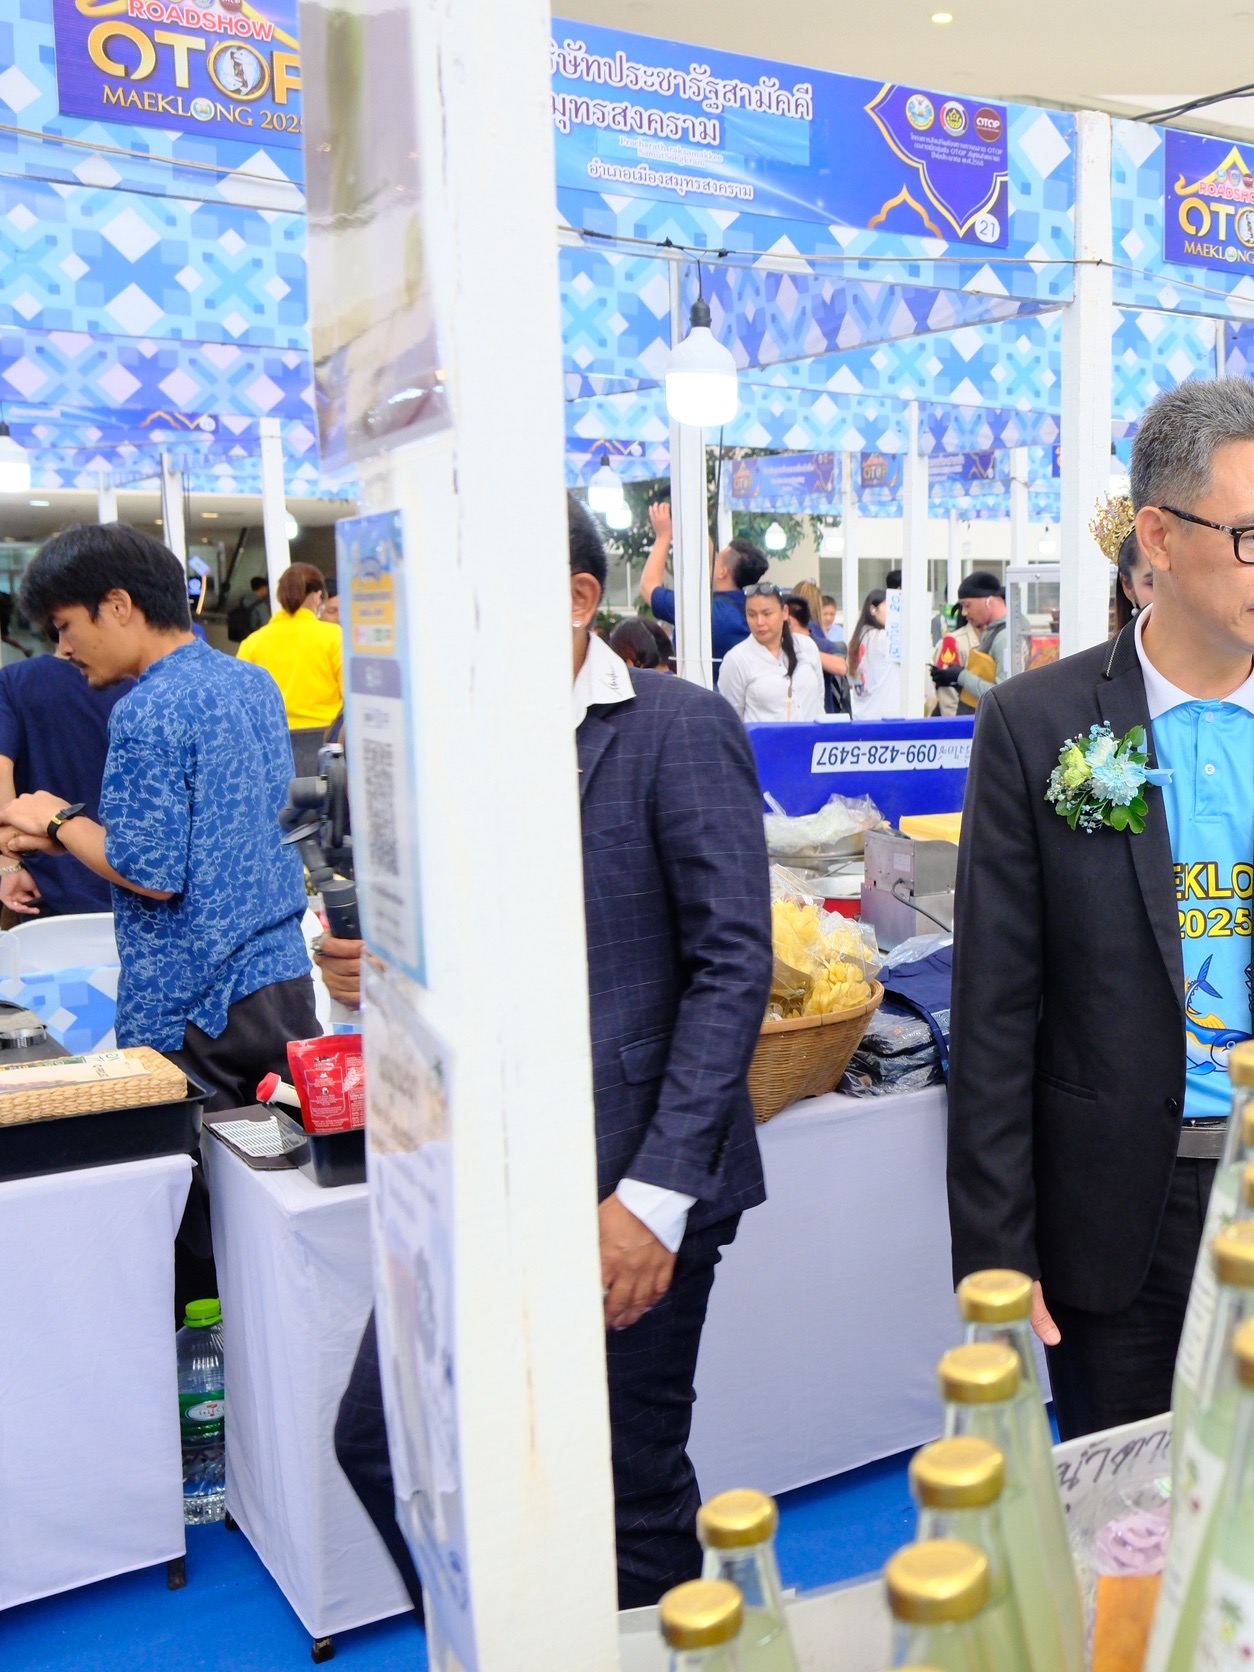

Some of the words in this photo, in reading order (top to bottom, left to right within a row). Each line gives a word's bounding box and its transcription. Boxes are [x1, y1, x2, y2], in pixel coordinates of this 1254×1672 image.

[128, 0, 274, 41] ROADSHOW
[102, 84, 253, 127] MAEKLONG
[259, 110, 302, 134] 202
[976, 116, 1000, 129] OTOP
[979, 219, 996, 237] 21
[816, 743, 937, 767] 099-428-5497
